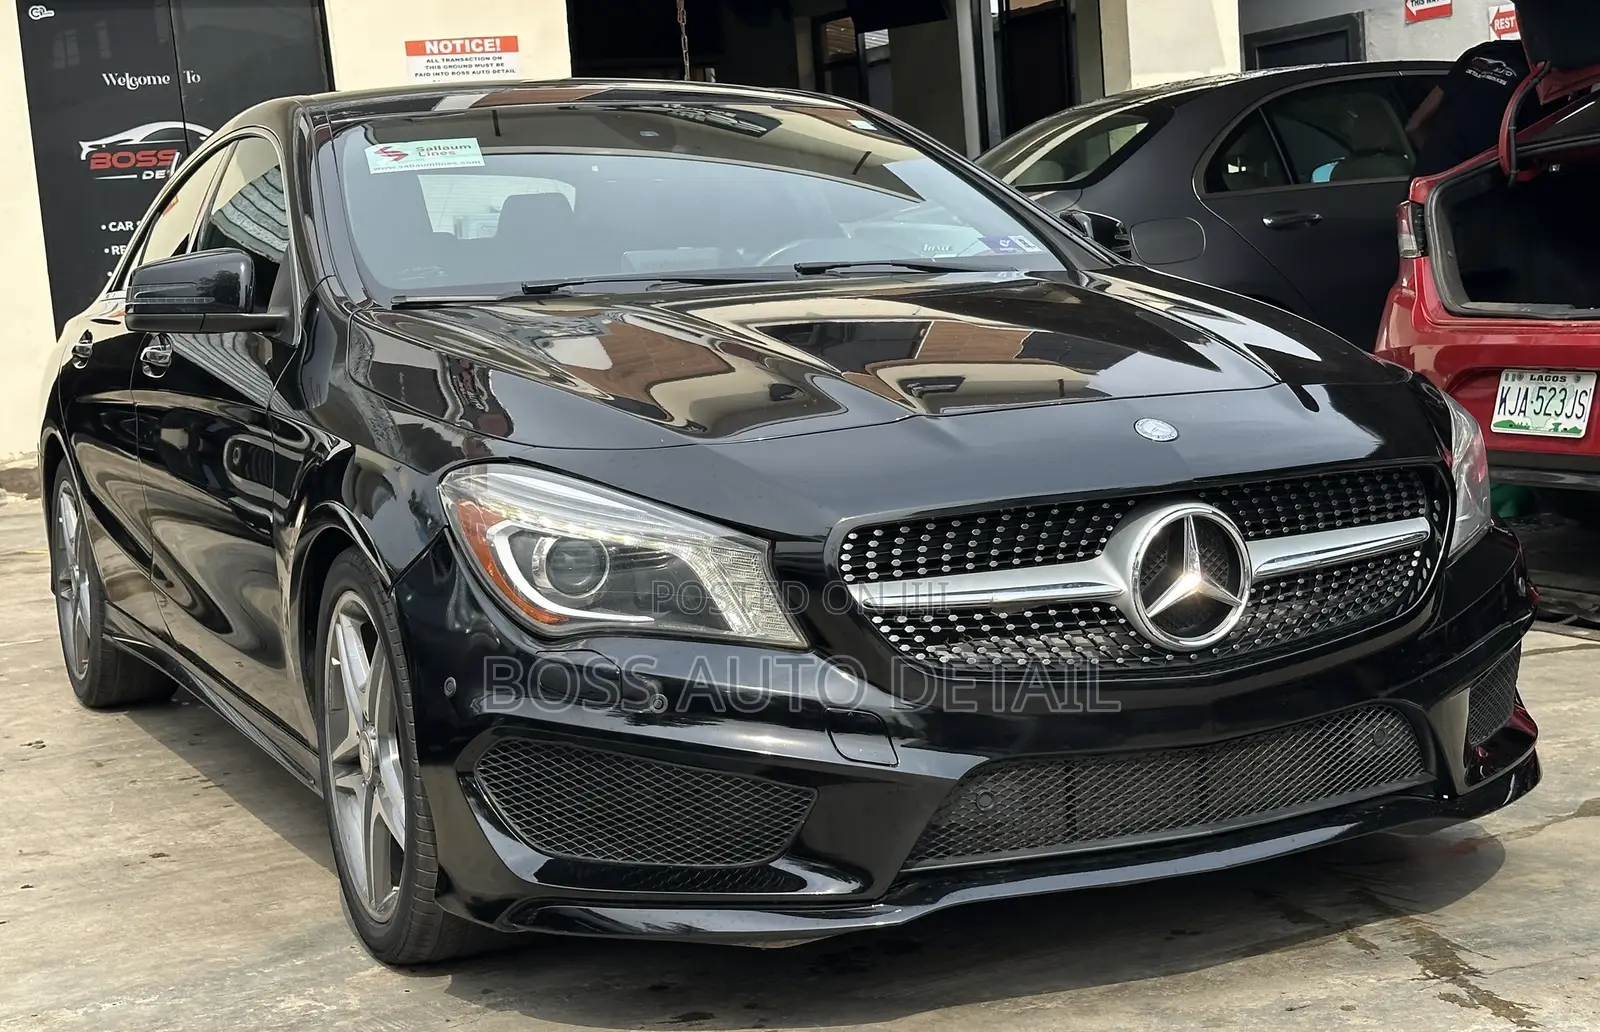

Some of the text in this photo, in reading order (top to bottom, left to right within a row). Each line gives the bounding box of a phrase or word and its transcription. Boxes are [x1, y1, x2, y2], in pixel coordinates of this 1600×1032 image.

[1494, 16, 1514, 30] REST
[424, 38, 501, 54] NOTICE!
[102, 70, 201, 90] Welcome To
[416, 144, 472, 152] Sallaum
[90, 149, 177, 169] BOSS
[108, 221, 134, 231] CAR
[1529, 374, 1567, 382] LAGOS
